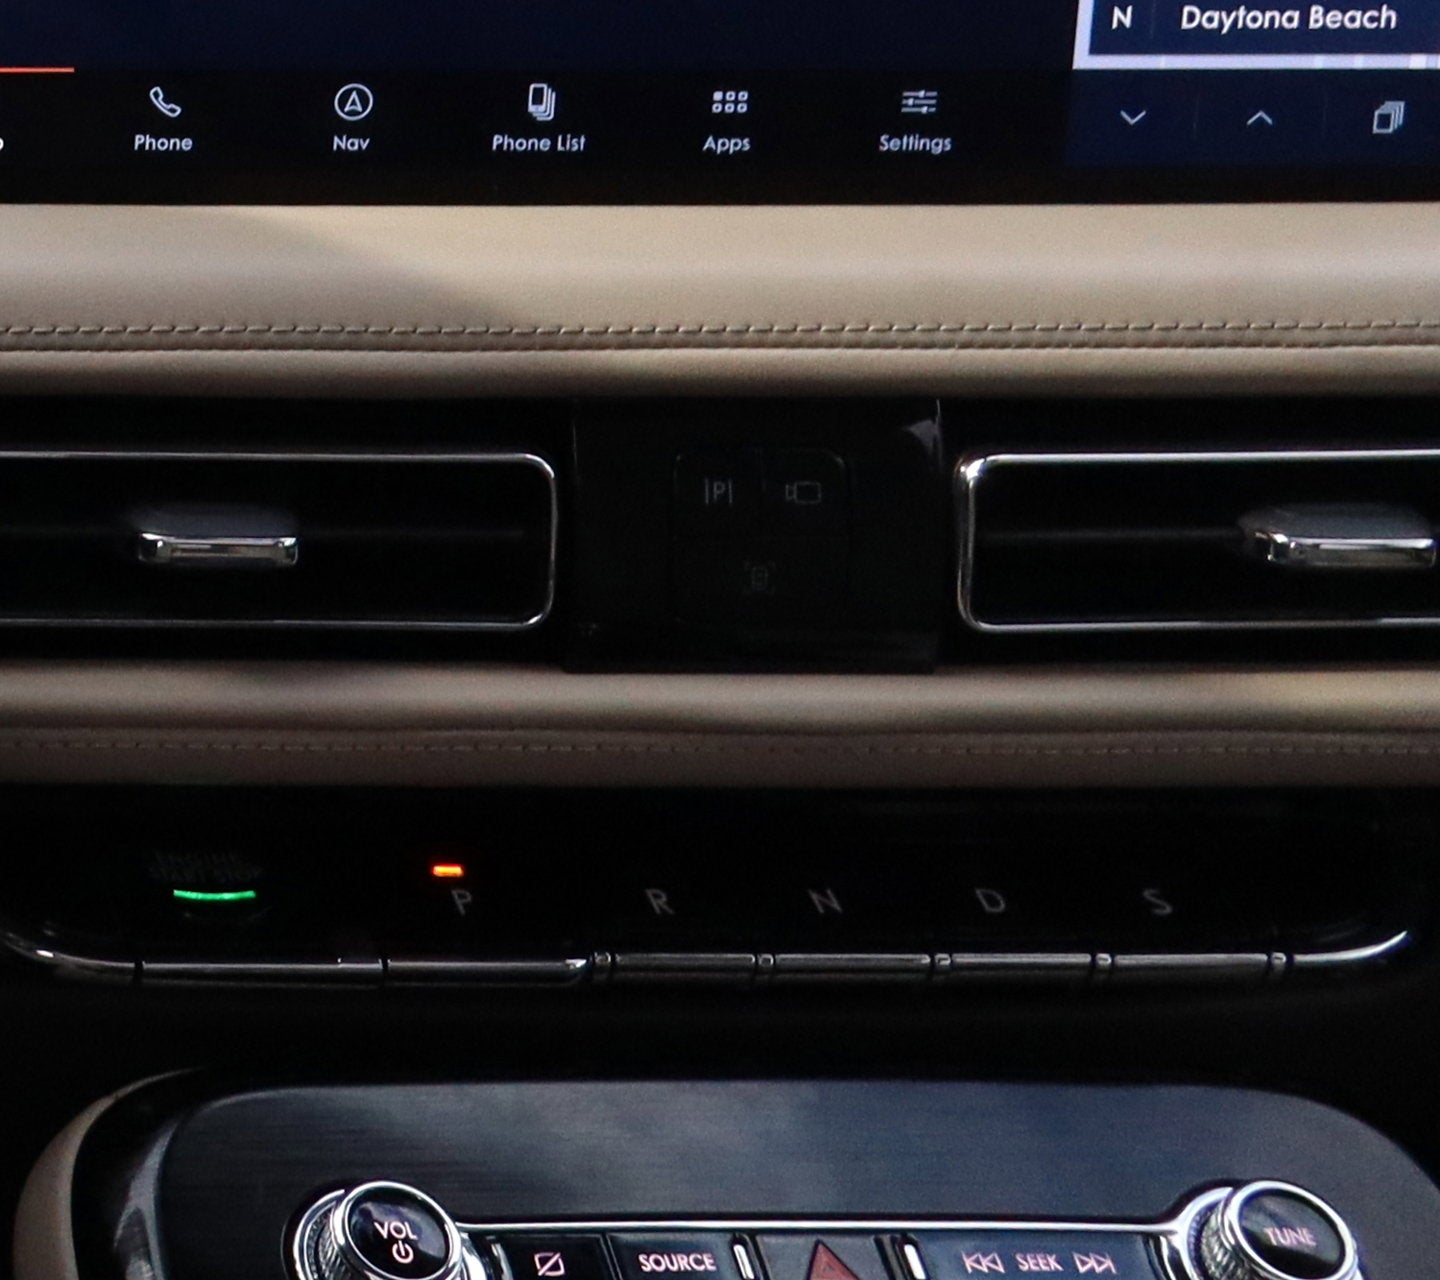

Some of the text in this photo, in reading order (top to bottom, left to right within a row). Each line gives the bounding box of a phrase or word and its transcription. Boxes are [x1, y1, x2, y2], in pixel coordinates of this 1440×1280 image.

[1111, 4, 1398, 34] N Daytona Beach
[133, 134, 194, 152] Phone
[332, 135, 371, 152] Nav
[491, 134, 586, 152] Phone List
[702, 135, 751, 154] Apps
[879, 134, 953, 155] Settings
[373, 1219, 419, 1242] VOL
[1261, 1225, 1318, 1248] TUNE
[636, 1251, 718, 1273] SOURCE
[1015, 1252, 1064, 1273] SEEK
